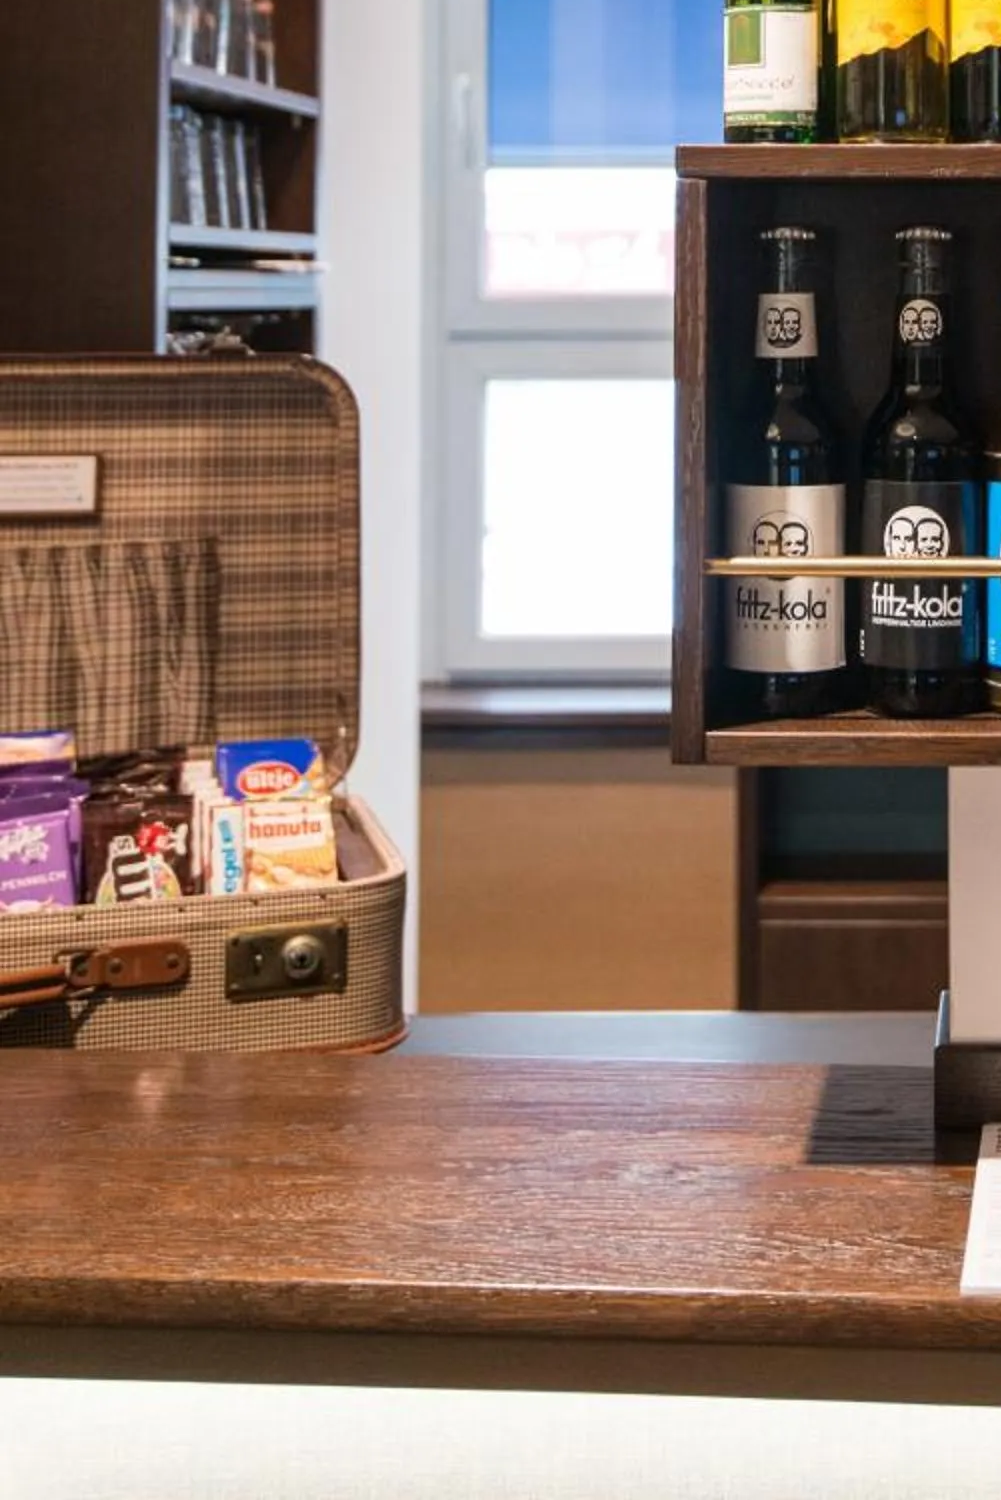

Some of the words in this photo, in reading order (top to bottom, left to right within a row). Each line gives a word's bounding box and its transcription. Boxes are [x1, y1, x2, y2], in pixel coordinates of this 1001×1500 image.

[737, 587, 828, 621] fritz-kola
[871, 581, 963, 618] fritz-kola
[249, 818, 322, 840] hanuta
